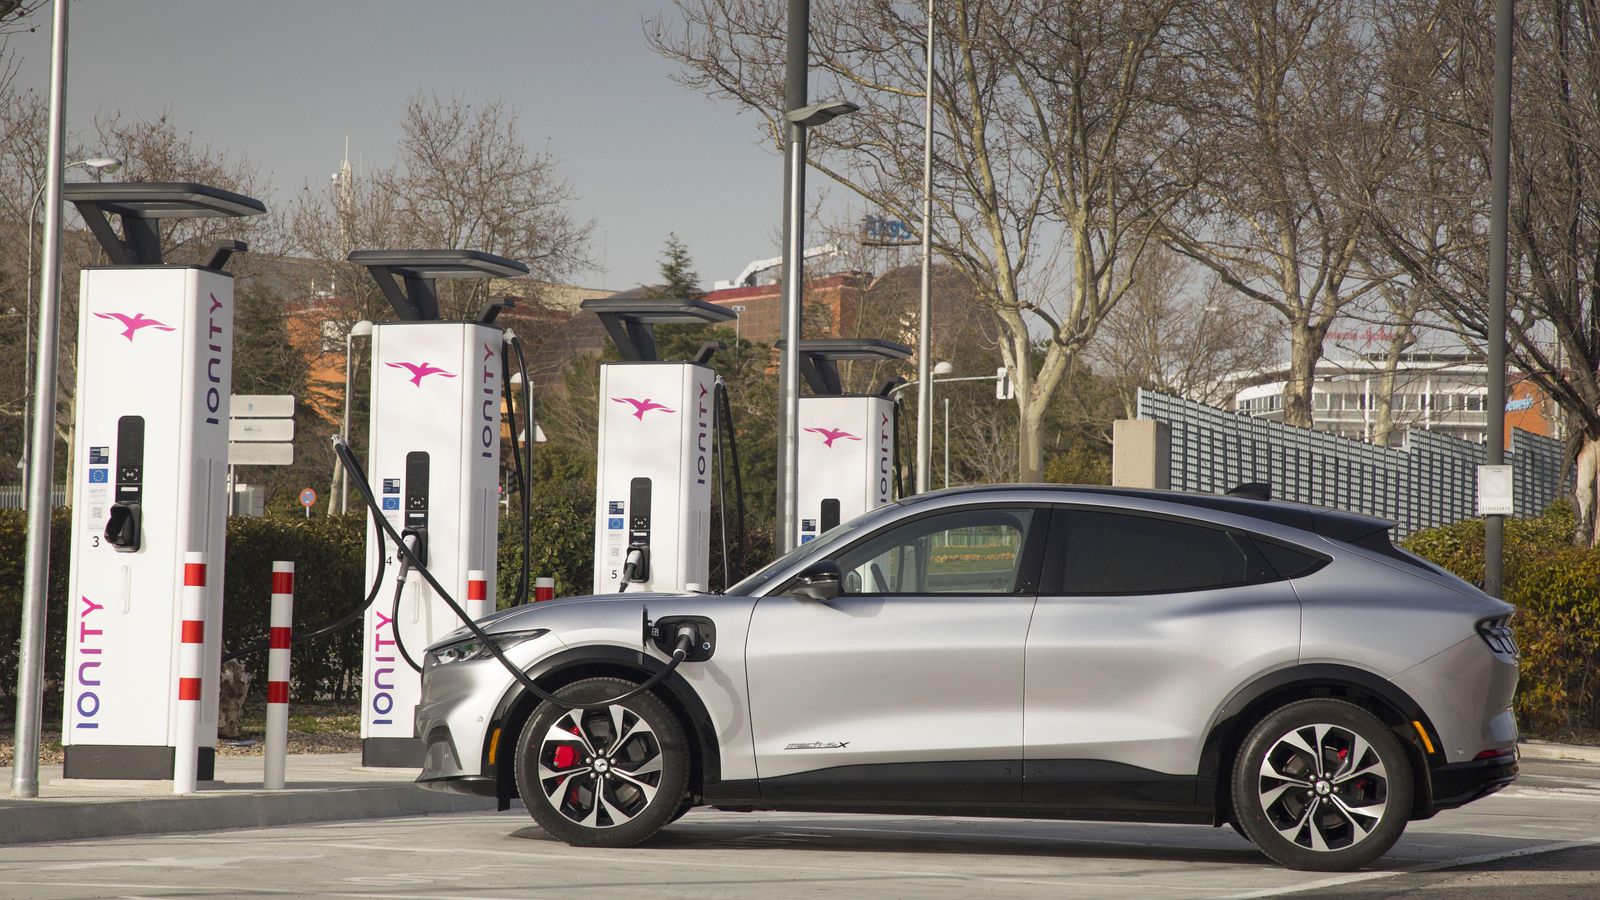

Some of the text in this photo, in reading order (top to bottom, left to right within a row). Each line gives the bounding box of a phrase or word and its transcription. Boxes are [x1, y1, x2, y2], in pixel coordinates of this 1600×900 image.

[206, 291, 223, 425] IONITY
[482, 342, 494, 458] IONITY
[697, 381, 708, 484] IONITY
[880, 411, 889, 503] IONITY
[92, 535, 100, 548] 3
[385, 555, 393, 566] 4
[611, 569, 618, 580] 5
[76, 595, 104, 729] IONITY
[372, 610, 396, 725] IONITY
